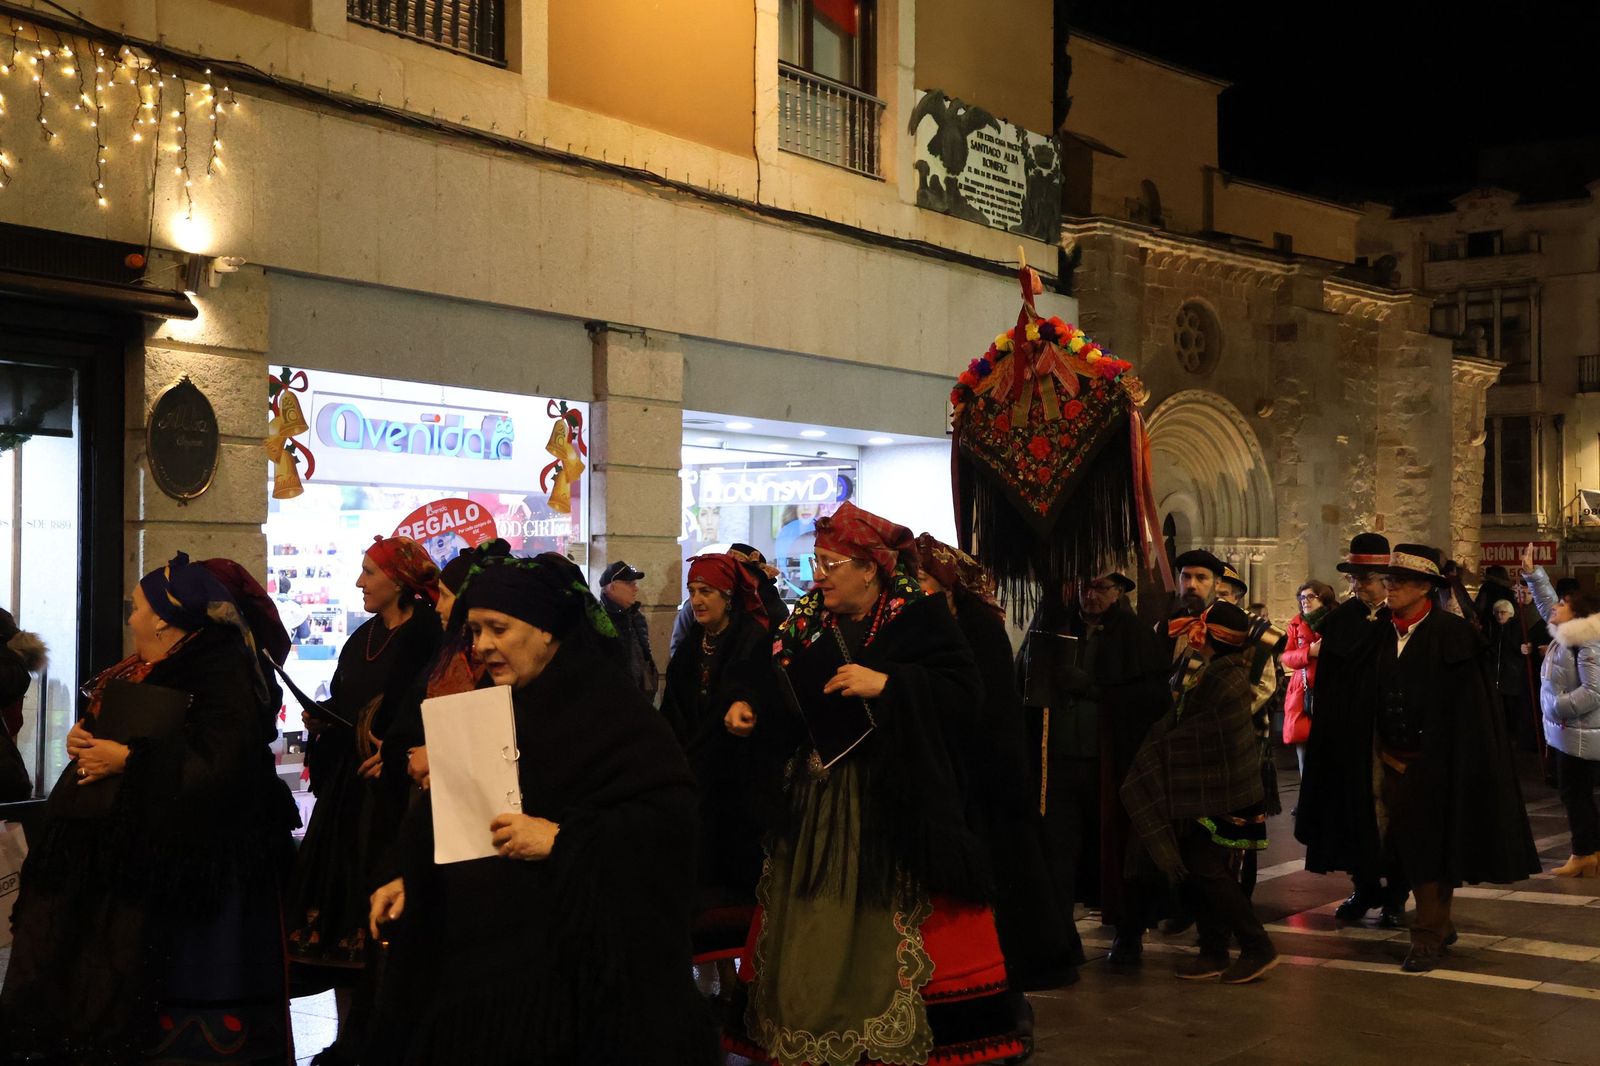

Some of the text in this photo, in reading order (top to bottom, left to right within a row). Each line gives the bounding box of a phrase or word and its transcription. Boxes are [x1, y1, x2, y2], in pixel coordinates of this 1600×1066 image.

[971, 140, 1019, 165] SANTIAGO ALBA
[983, 157, 1008, 174] BONIFAZ
[1584, 508, 1600, 516] 98
[398, 503, 479, 541] REGALO
[496, 520, 521, 537] OD
[1480, 544, 1515, 561] ACIÓN
[1517, 546, 1552, 561] TTAL
[0, 878, 16, 892] OP
